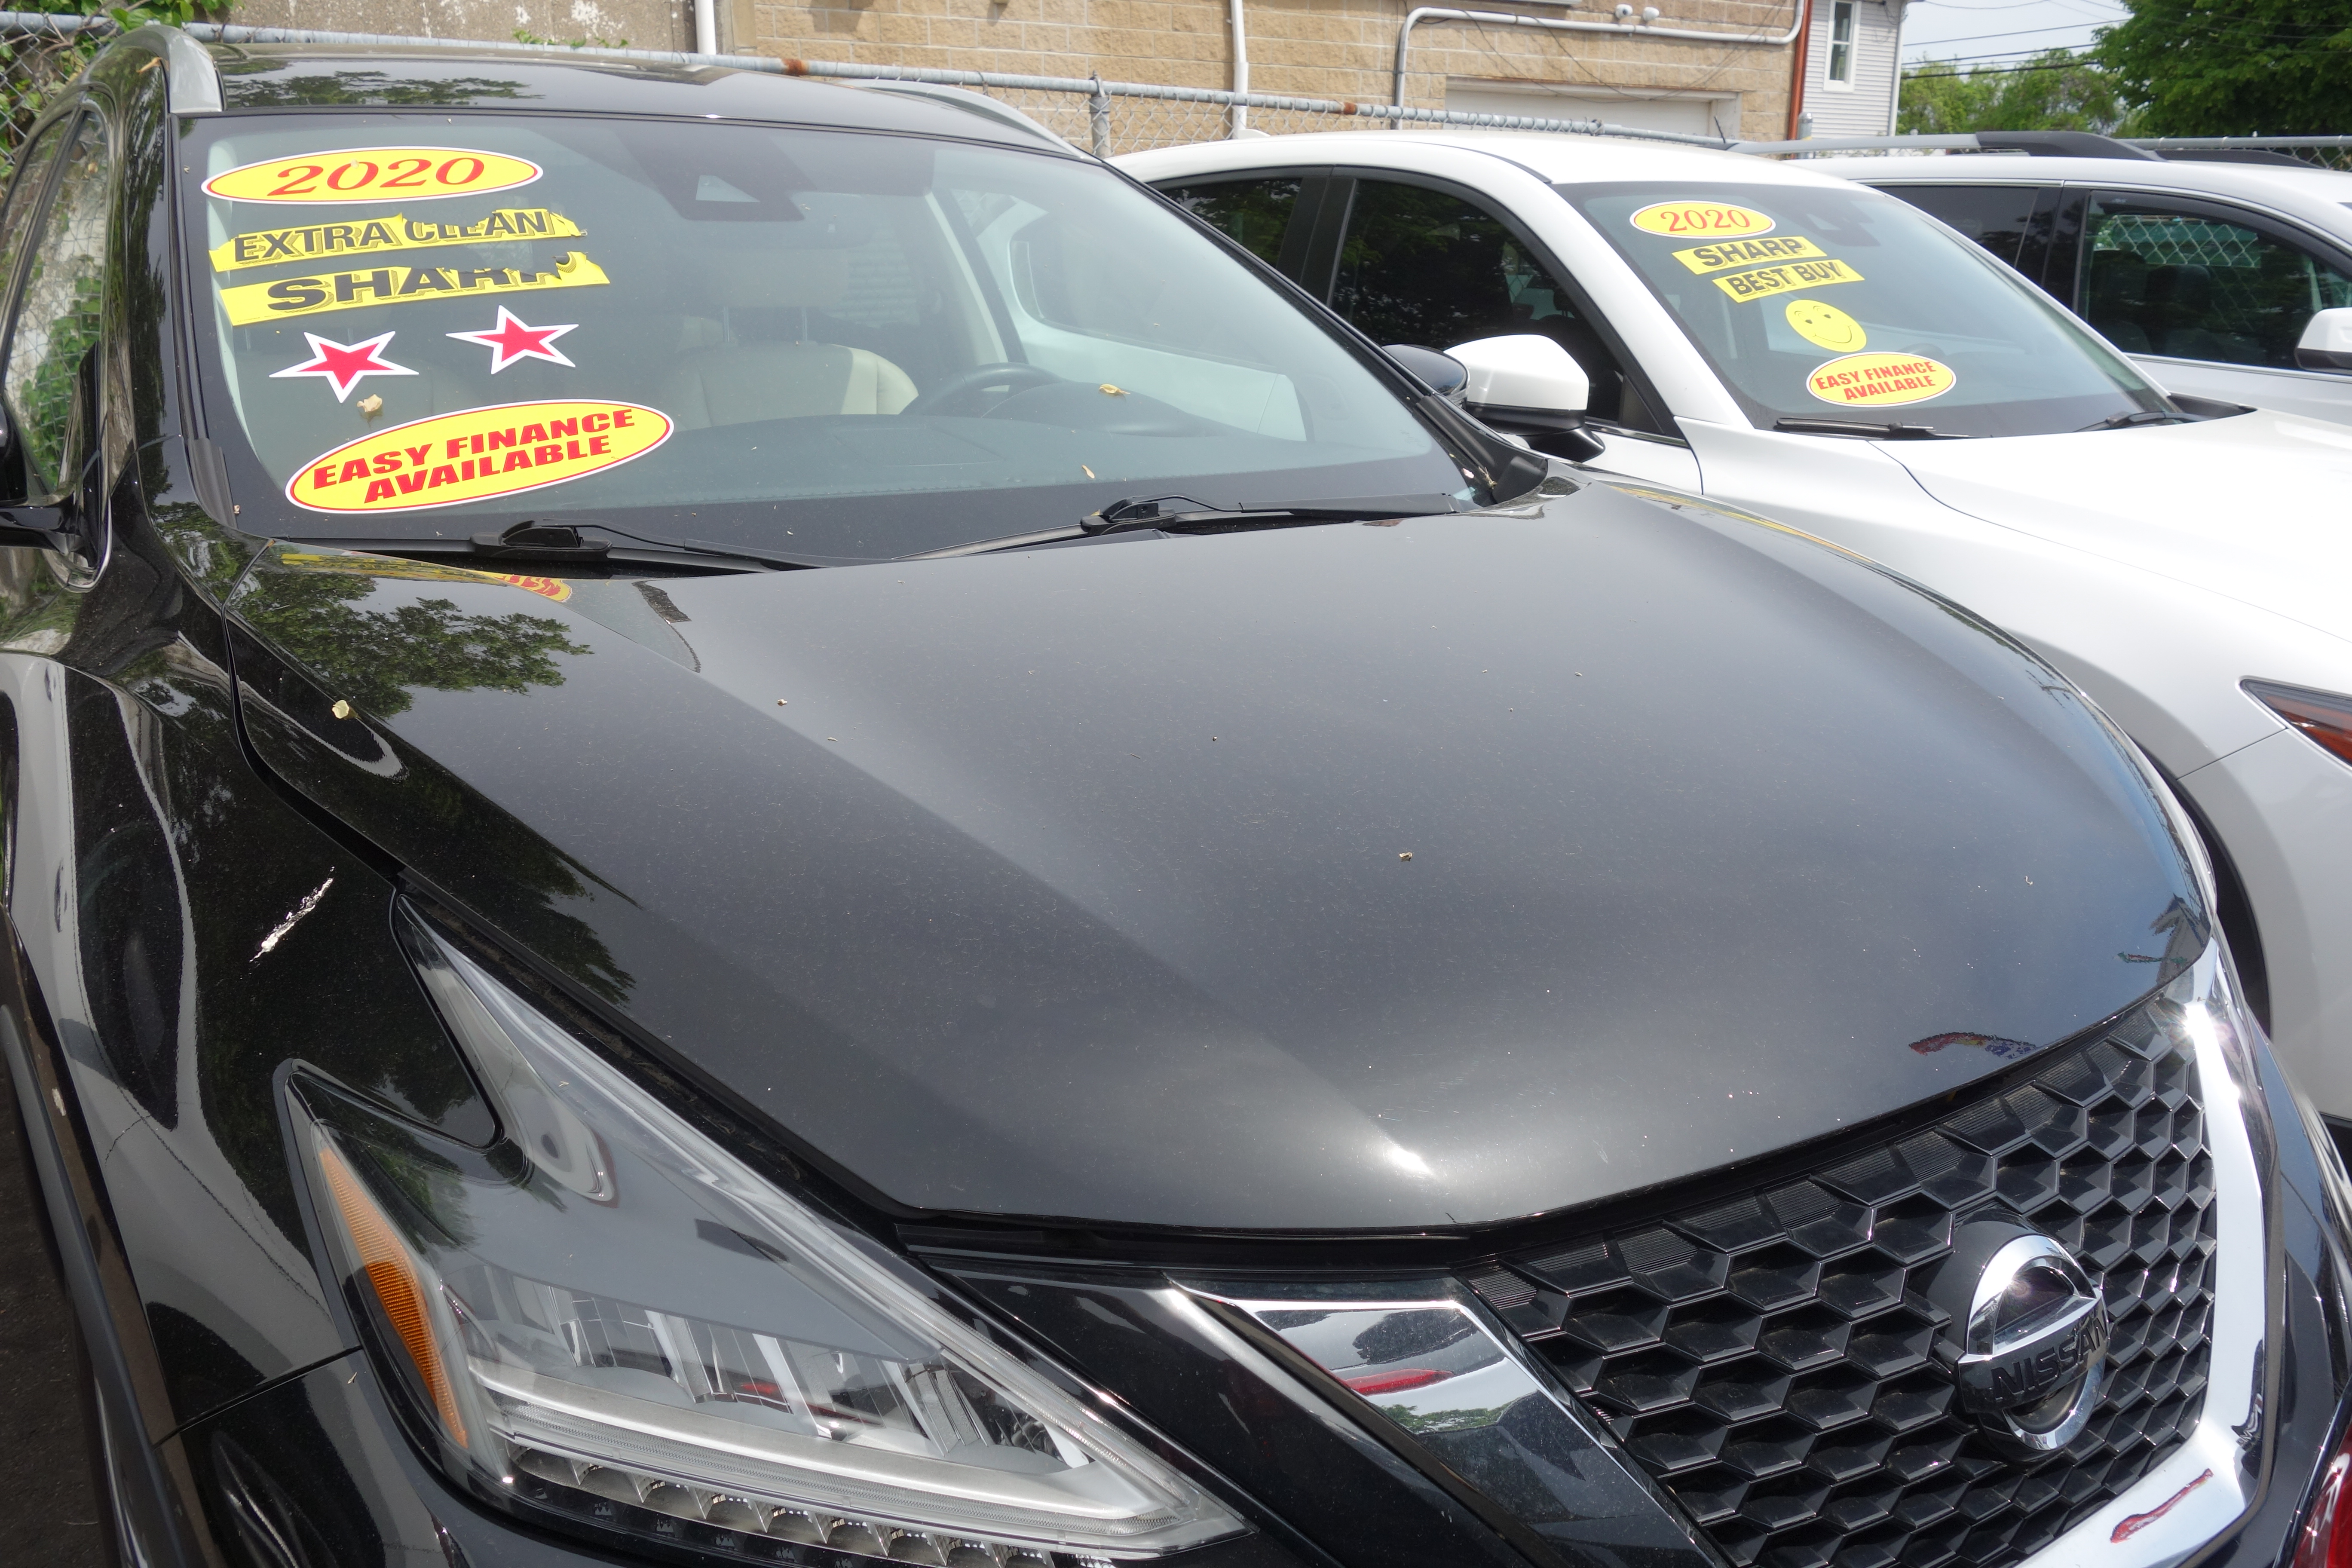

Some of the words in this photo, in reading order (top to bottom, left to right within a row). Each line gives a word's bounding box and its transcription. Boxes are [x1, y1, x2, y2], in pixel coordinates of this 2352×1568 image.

[267, 156, 484, 197] 2020
[1660, 209, 1751, 232] 2020
[234, 222, 395, 263] EXTRA
[1693, 238, 1803, 267] SHARP
[1727, 268, 1792, 296] BEST
[1796, 261, 1843, 282] BUY
[1815, 371, 1862, 390] EASY
[1865, 361, 1936, 380] FINANCE
[1844, 375, 1936, 400] AVAILABLE
[313, 442, 433, 490] EASY
[446, 408, 635, 460] FINANCE
[364, 435, 611, 504] AVAILABLE
[1991, 1315, 2107, 1401] NISSAN
